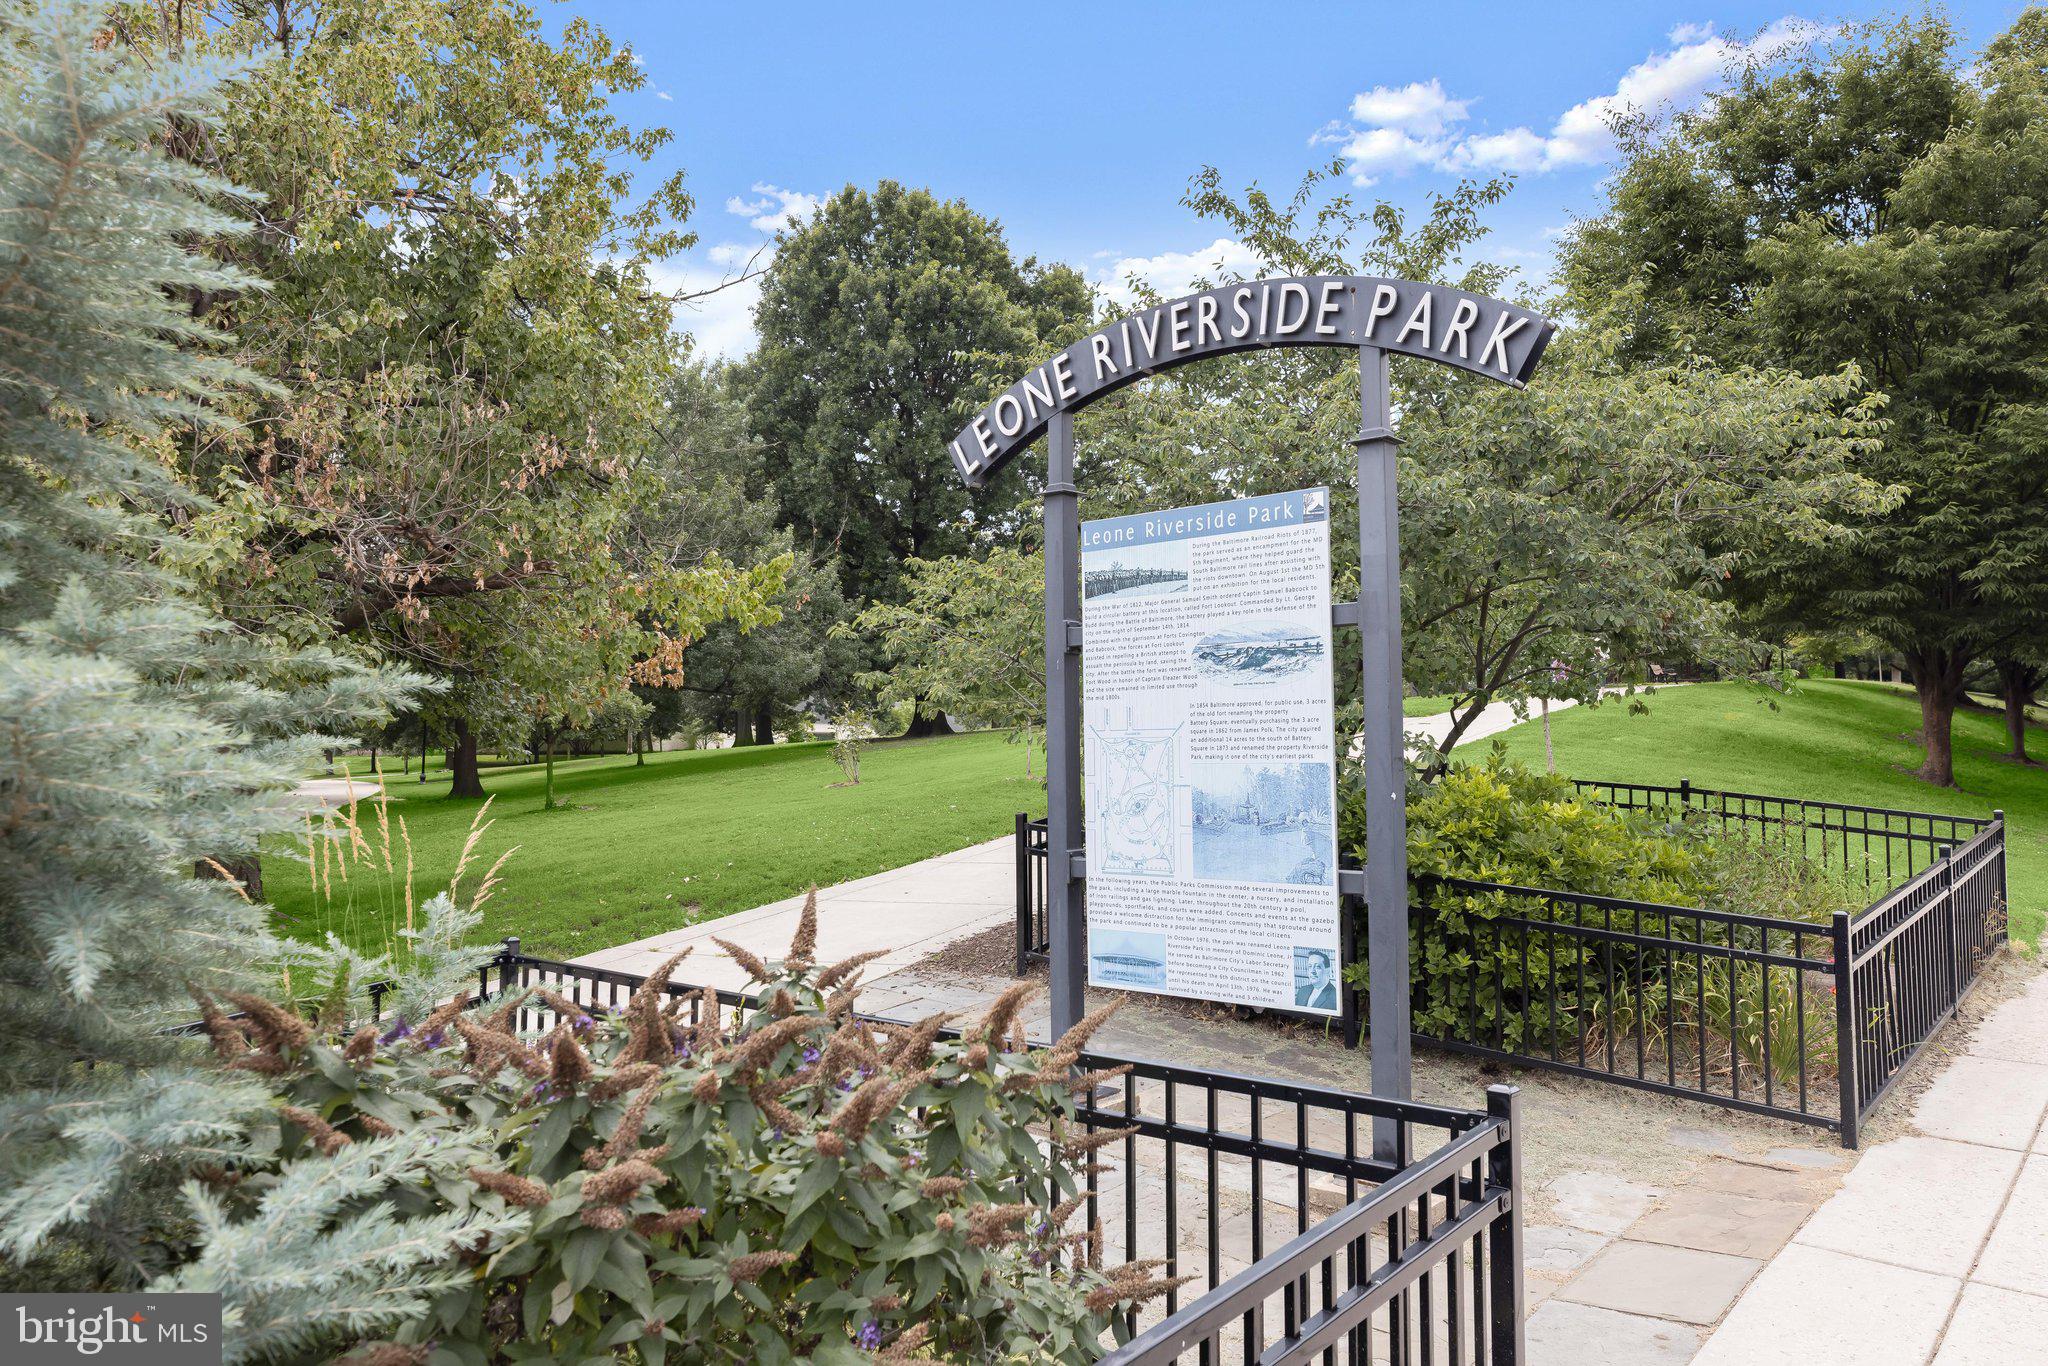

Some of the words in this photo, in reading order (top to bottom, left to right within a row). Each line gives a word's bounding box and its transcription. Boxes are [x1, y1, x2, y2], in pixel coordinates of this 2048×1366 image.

[951, 353, 1077, 475] LEONE
[1092, 281, 1343, 380] RIVERSIDE
[1365, 283, 1528, 374] PARK
[1084, 528, 1135, 546] Leone
[1145, 510, 1237, 538] Riverside
[1248, 500, 1294, 524] Park
[1222, 537, 1249, 545] Baltimore
[1251, 533, 1275, 542] Railroad
[1202, 549, 1215, 557] park
[1252, 541, 1289, 550] encampment
[1264, 550, 1285, 558] helped
[1285, 548, 1303, 557] guard
[1280, 557, 1306, 565] assisting
[1258, 568, 1279, 576] August
[1220, 580, 1249, 588] exhibition
[1274, 699, 1292, 707] public
[1259, 717, 1290, 725] purchasing
[1105, 877, 1131, 885] following
[1196, 882, 1232, 890] Commission
[1275, 887, 1321, 895] improvements
[1143, 913, 1174, 921] distraction
[1197, 917, 1227, 925] immigrant
[1228, 920, 1262, 929] community
[1202, 954, 1228, 963] Baltimore
[1263, 960, 1289, 970] Secretary
